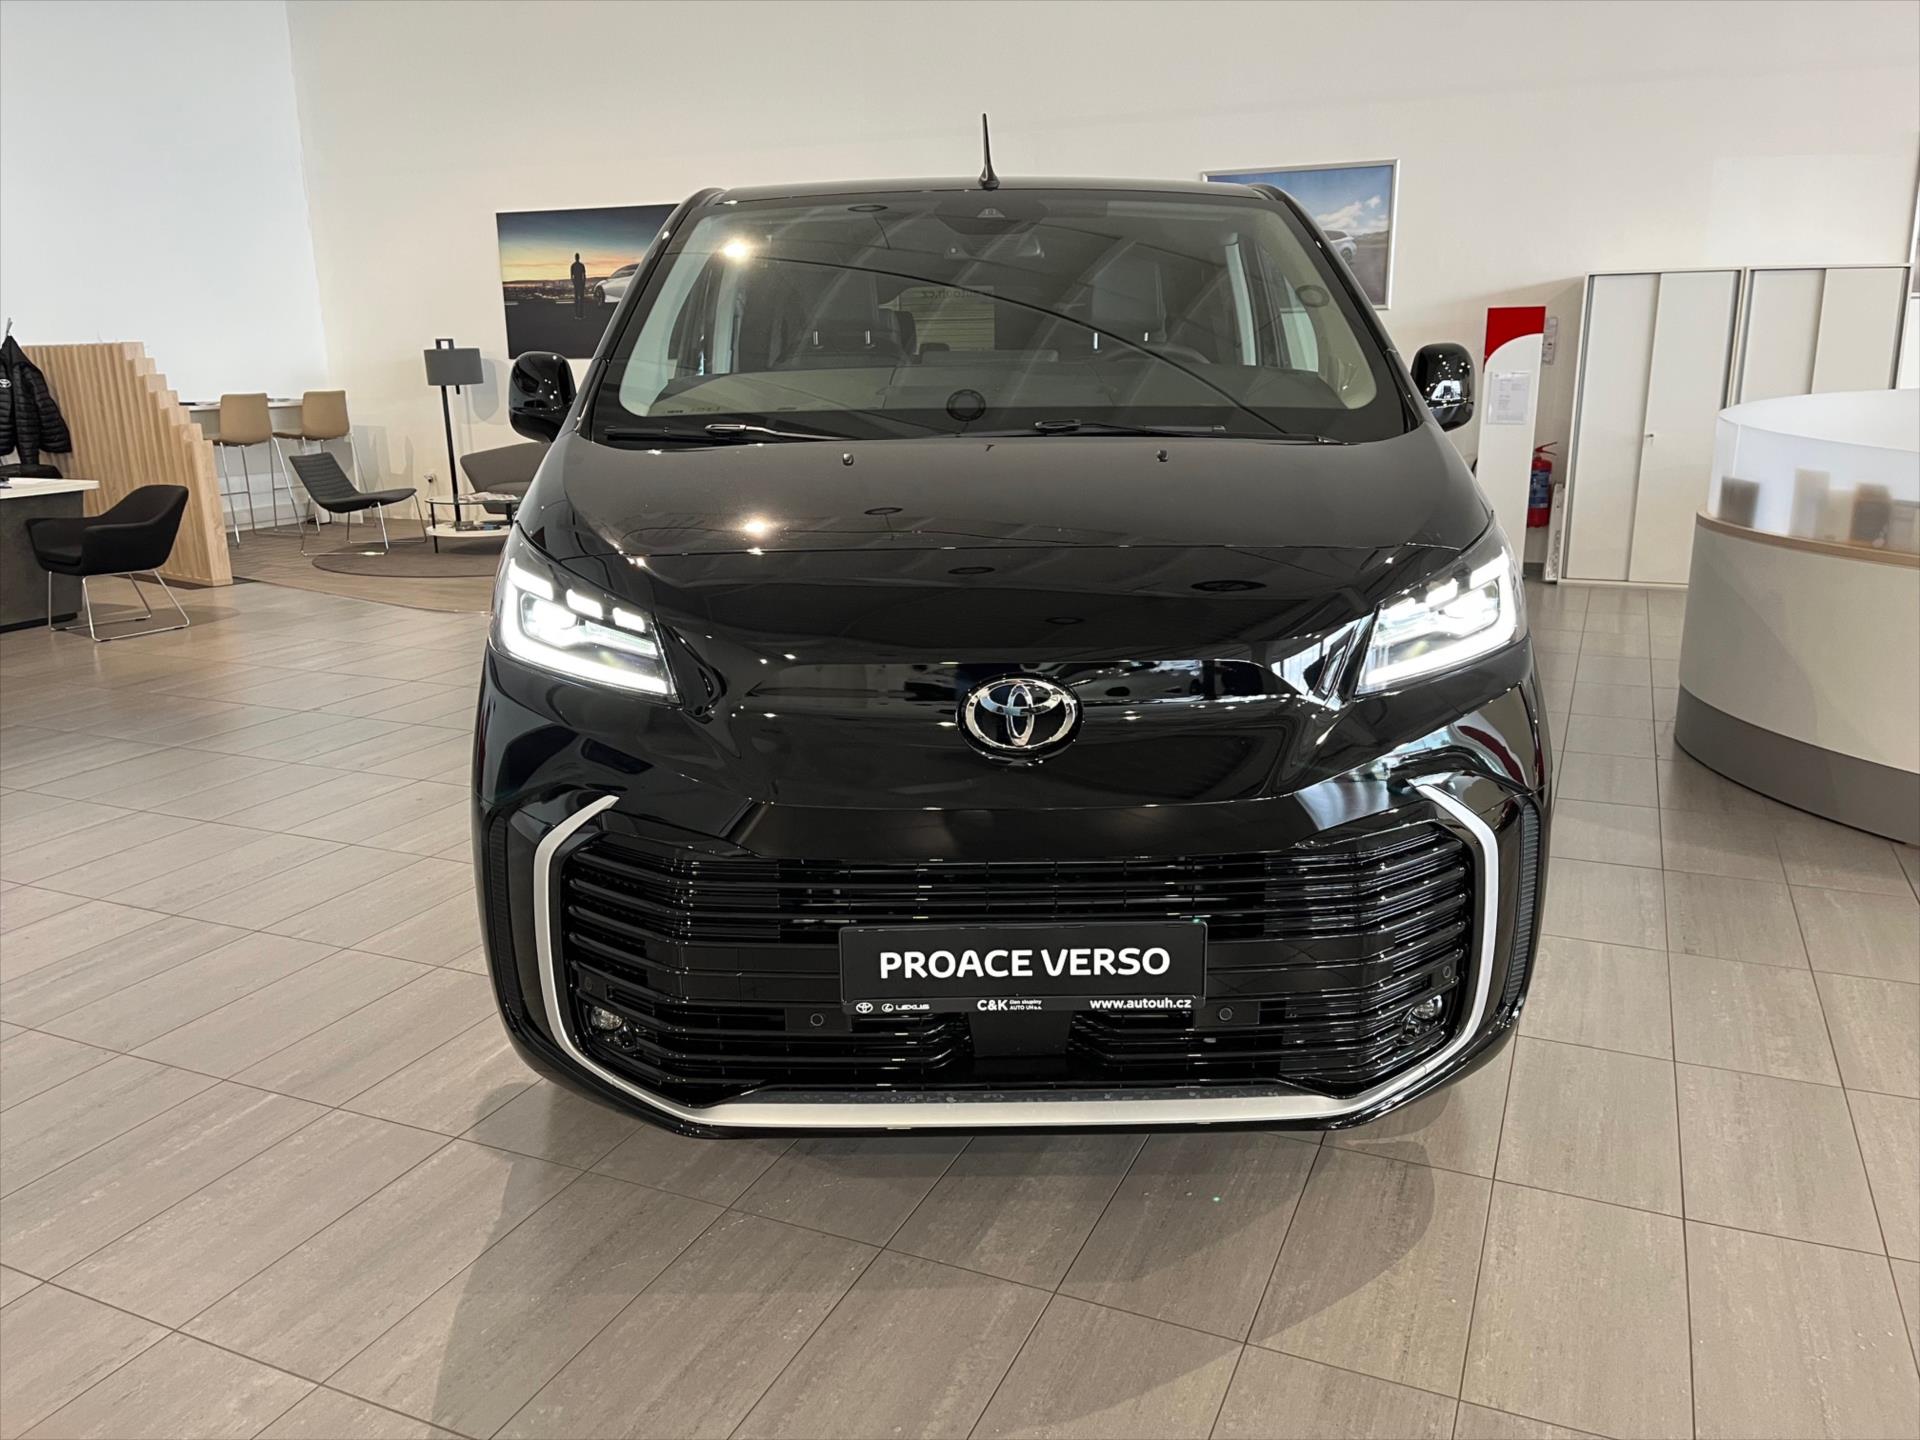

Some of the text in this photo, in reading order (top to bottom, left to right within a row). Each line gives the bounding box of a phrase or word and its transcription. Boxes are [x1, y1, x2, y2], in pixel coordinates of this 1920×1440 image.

[880, 948, 1171, 979] PROACE VERSO
[977, 999, 1008, 1011] C&K
[1090, 997, 1192, 1009] www.autouh.cz
